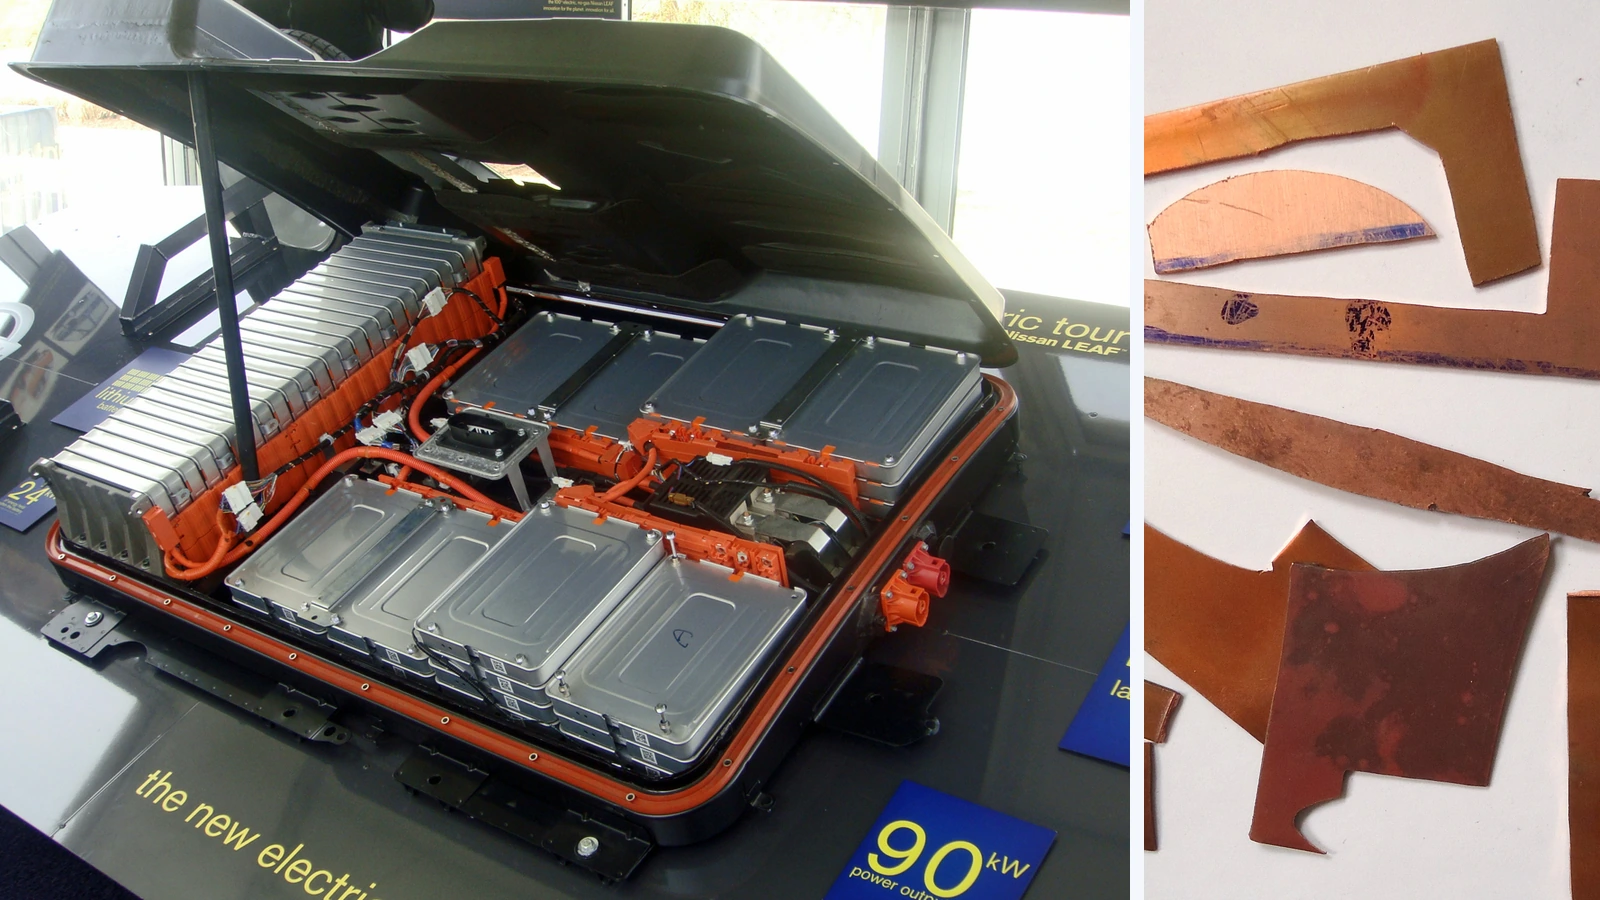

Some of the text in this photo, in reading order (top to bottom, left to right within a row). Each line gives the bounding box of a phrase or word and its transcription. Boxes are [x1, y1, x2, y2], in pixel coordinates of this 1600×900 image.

[1004, 329, 1058, 347] Nissan
[1052, 317, 1130, 344] tour
[8, 481, 50, 505] 24
[135, 769, 382, 900] the new electri
[867, 820, 1030, 898] 90 kW
[848, 866, 899, 890] power
